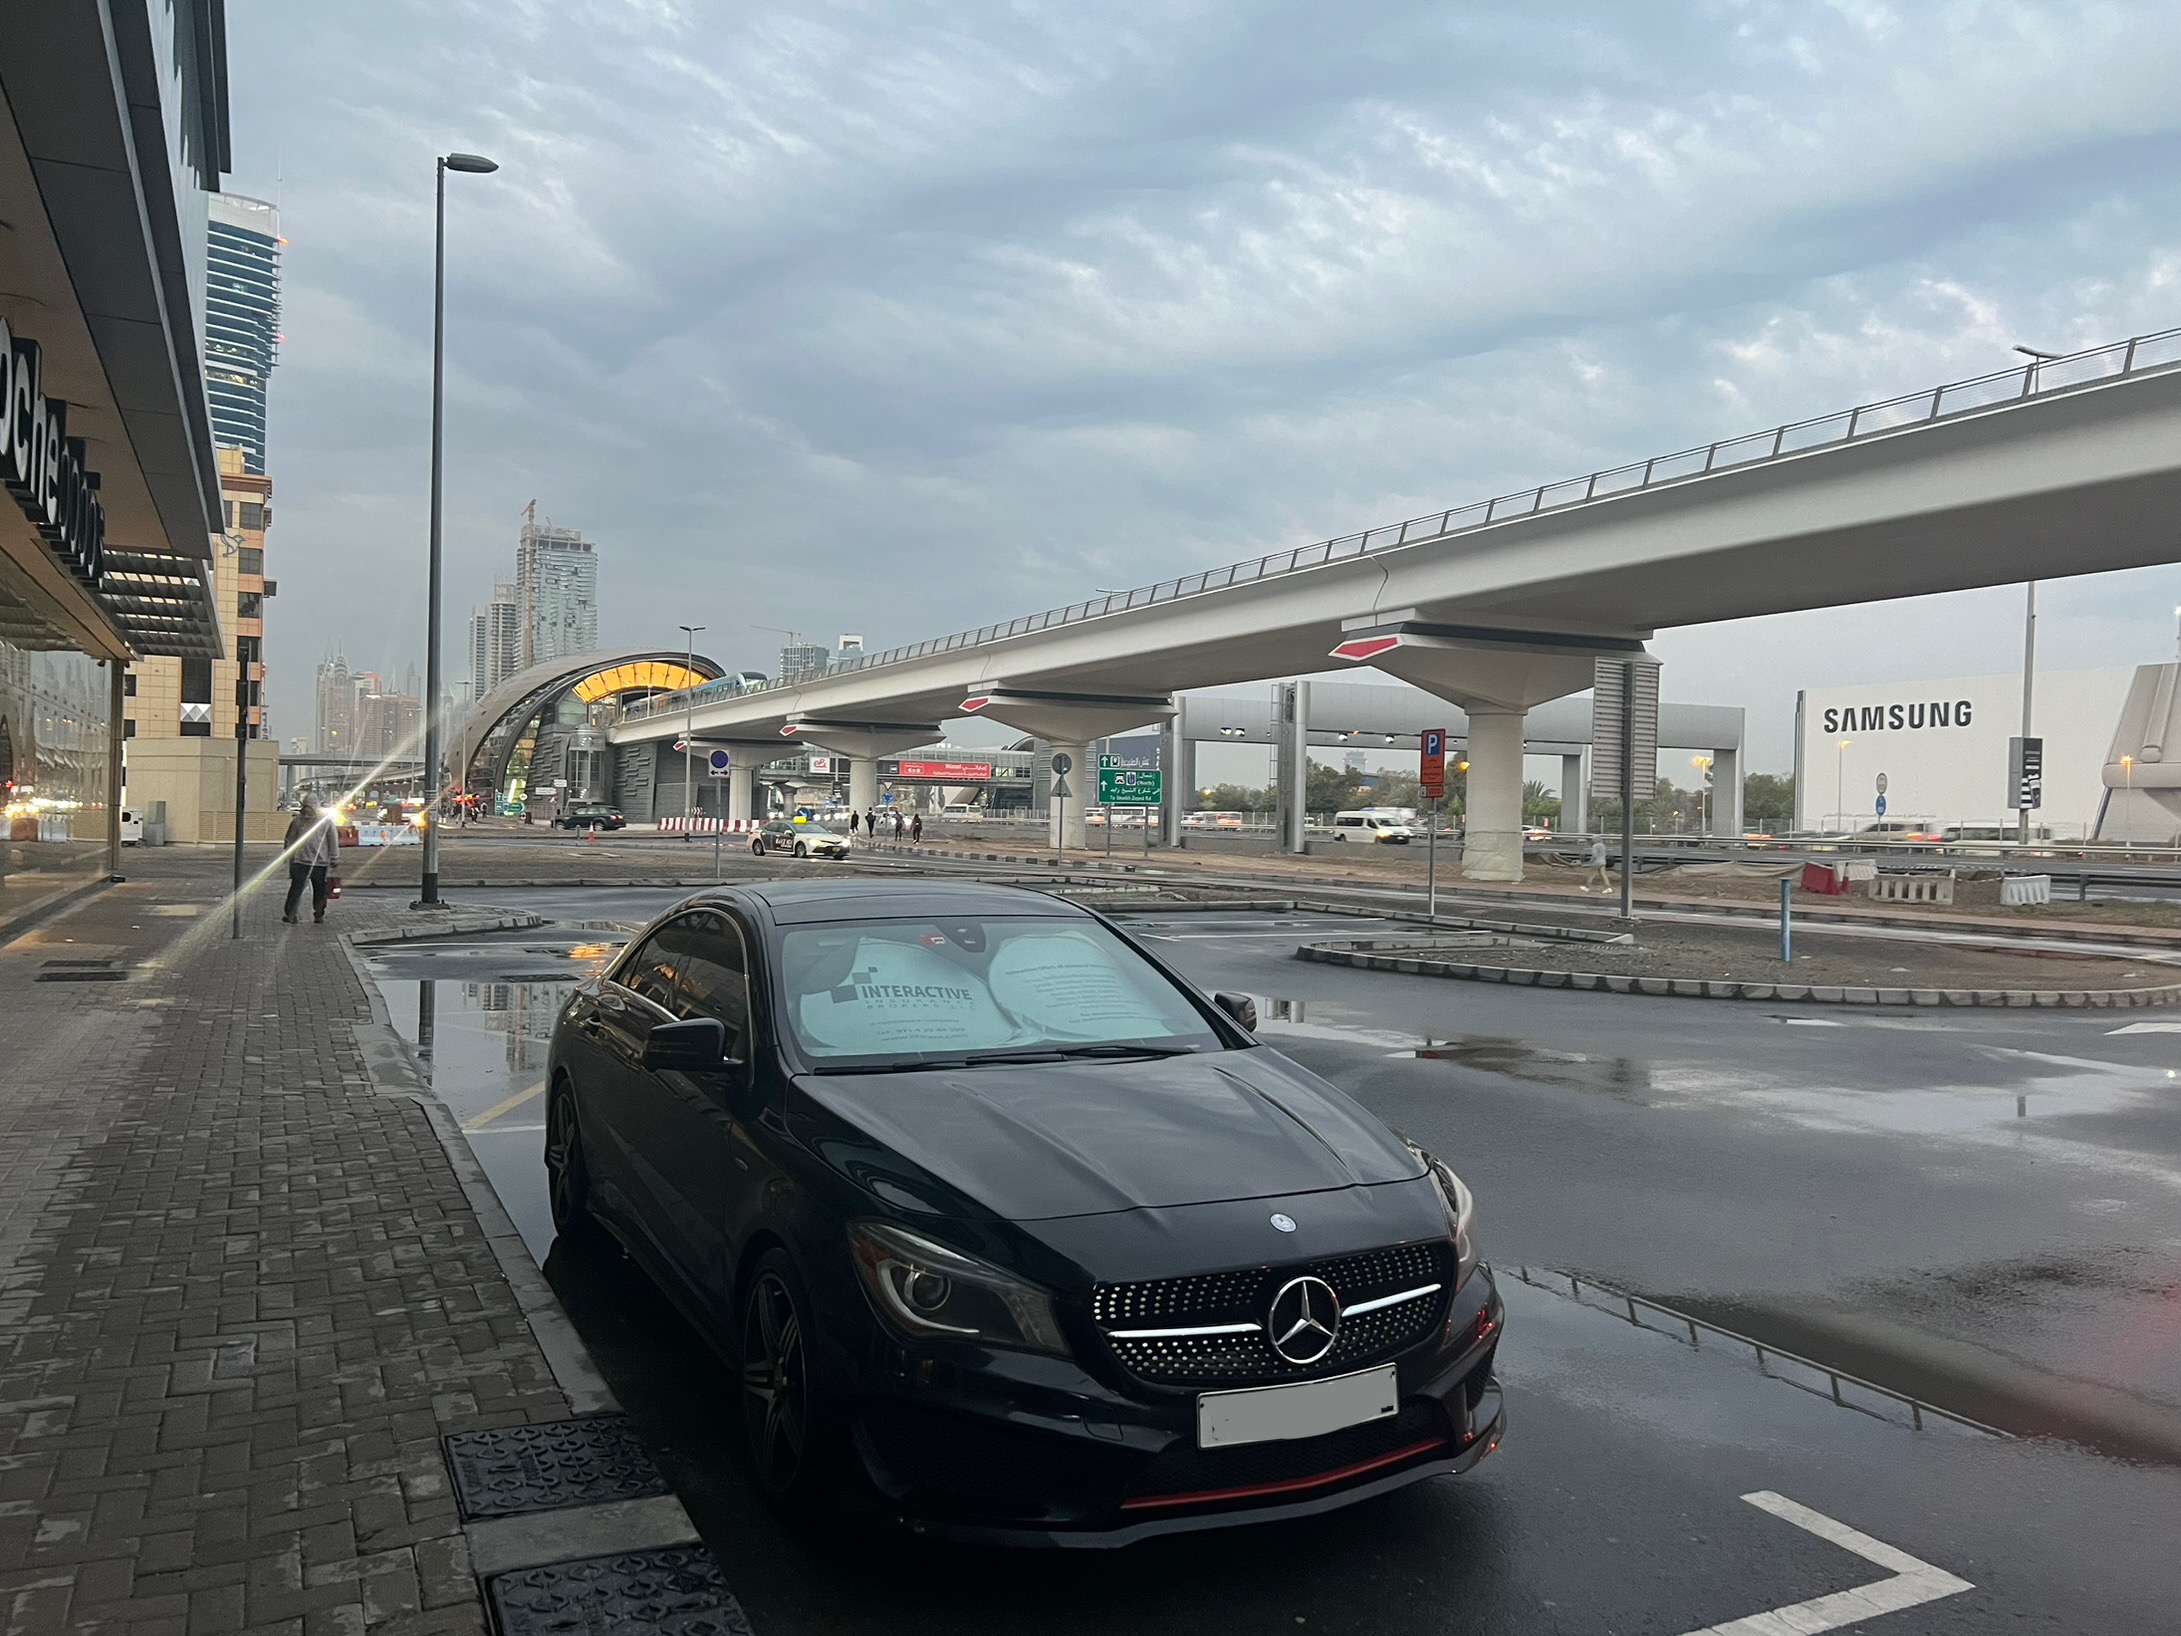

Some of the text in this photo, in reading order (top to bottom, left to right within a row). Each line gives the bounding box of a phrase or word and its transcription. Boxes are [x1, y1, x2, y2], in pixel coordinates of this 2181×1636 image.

[1824, 700, 1972, 733] SAMSUNG
[1427, 734, 1438, 754] P
[861, 985, 972, 1001] INTERACTIVE
